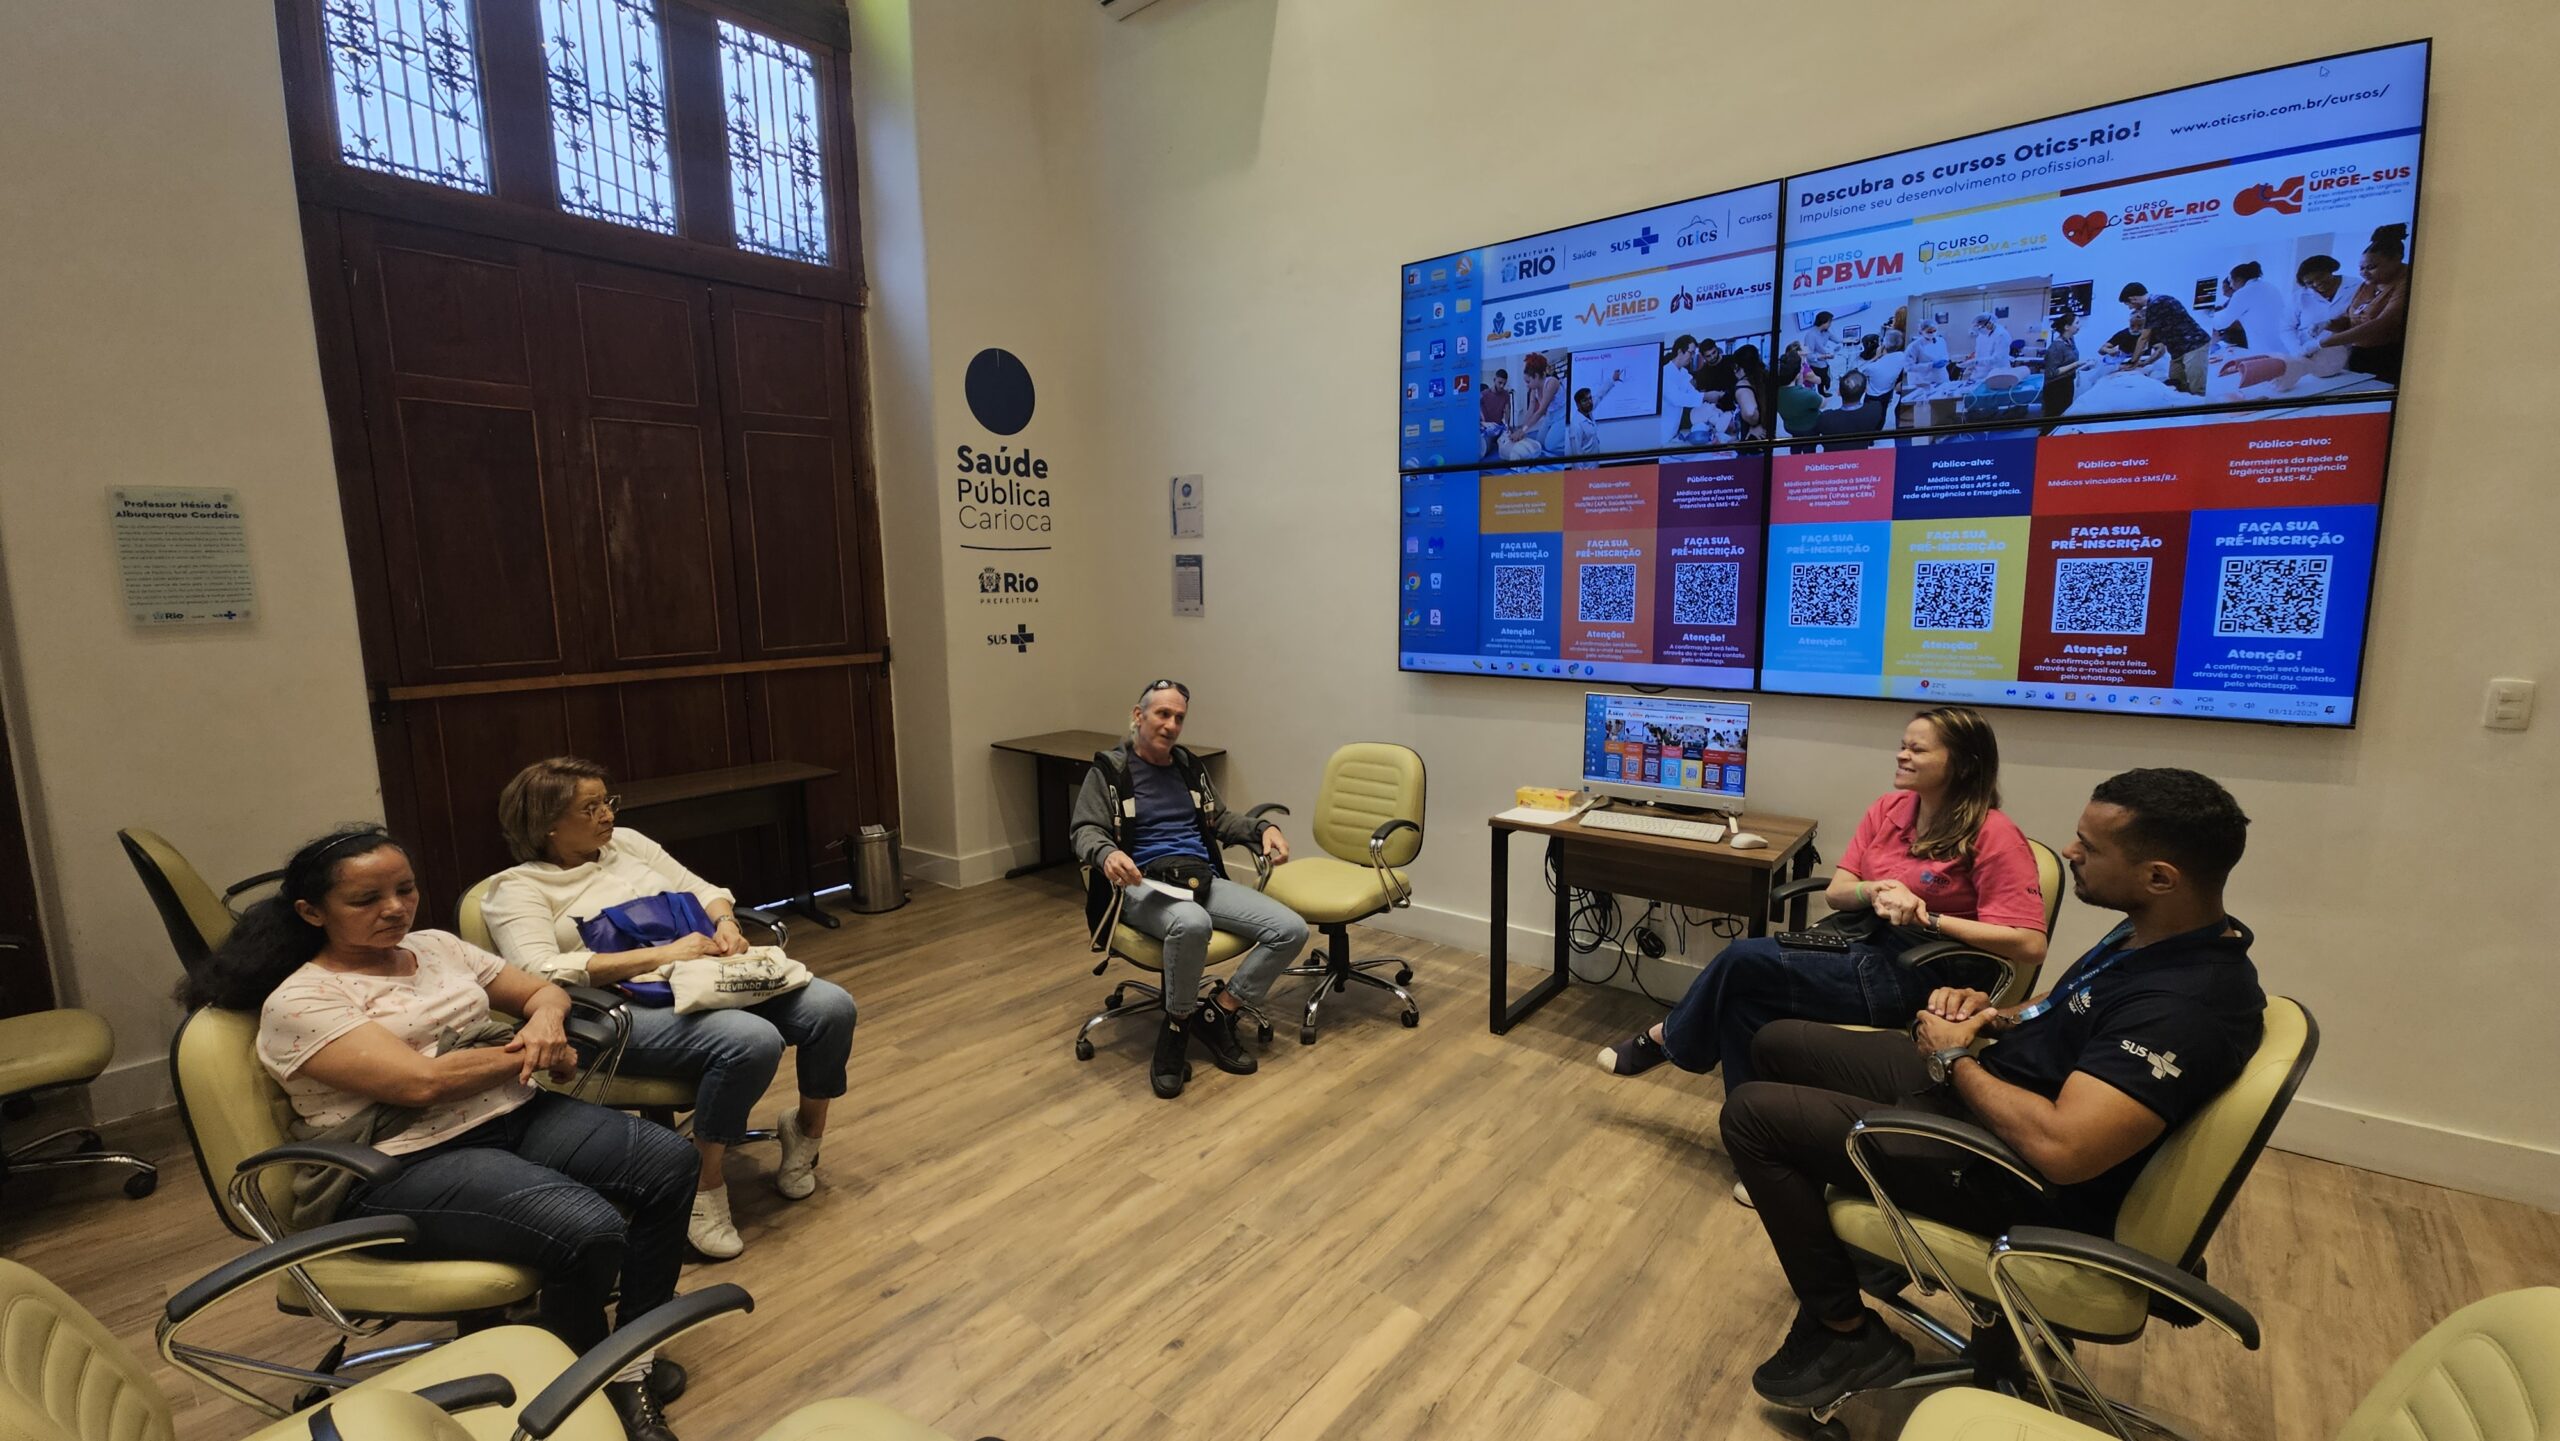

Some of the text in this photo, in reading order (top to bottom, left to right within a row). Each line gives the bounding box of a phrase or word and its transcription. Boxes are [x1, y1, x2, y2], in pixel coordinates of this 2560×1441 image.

[2170, 84, 2391, 135] www.oticsrio.com.br/cursos/
[1801, 120, 2141, 207] Descubra os cursos Otics-Rio!
[2310, 165, 2357, 179] CURSO
[2309, 166, 2411, 192] URGE-SUS
[1800, 150, 2115, 224] Impulsione seu desenvolvimento profissional.
[2123, 199, 2220, 225] SAVE-RIO
[2125, 199, 2168, 213] CURSO
[1738, 212, 1773, 225] Cursos
[1611, 239, 1631, 253] SUS
[1938, 234, 1989, 251] CURSO
[1572, 250, 1597, 261] Saúde
[1819, 250, 1863, 265] CURSO
[1519, 255, 1556, 280] RIO
[1816, 252, 1904, 287] PBVM
[1696, 282, 1772, 303] MANEVA-SUS
[1697, 282, 1727, 294] CURSO
[1606, 290, 1642, 303] CURSO
[1514, 308, 1546, 320] CURSO
[1606, 297, 1660, 318] IEMED
[1513, 315, 1563, 338] SBVE
[2249, 437, 2331, 449] Público-alvo:
[957, 445, 1048, 479] Saúde
[1805, 463, 1860, 471] Público-alvo:
[1932, 459, 1995, 469] Público-alvo:
[2077, 459, 2149, 469] Público-alvo:
[2230, 458, 2289, 467] Enfermeiros
[2306, 455, 2333, 463] Rede
[2335, 454, 2349, 462] de
[2229, 468, 2274, 477] Urgência
[2285, 464, 2347, 474] Emergência
[1687, 475, 1734, 483] Público-alvo:
[1927, 475, 1959, 483] Médicos
[2085, 477, 2132, 485] vinculados
[2257, 475, 2271, 483] da
[957, 478, 1050, 507] Pública
[1915, 483, 1959, 491] Enfermeiros
[1932, 490, 1966, 499] Urgência
[123, 500, 177, 508] Professor
[214, 501, 228, 509] de
[116, 510, 239, 519] Albuquerque Cordeiro
[959, 505, 1051, 531] Carioca
[2071, 526, 2141, 539] FAÇA SUA
[2239, 521, 2319, 535] FAÇA SUA
[1684, 537, 1730, 547] FAÇA SUA
[2051, 536, 2162, 551] PRÉ-INSCRIÇÃO
[2215, 532, 2345, 548] PRÉ-INSCRIÇÃO
[1671, 546, 1745, 557] PRÉ-INSCRIÇÃO
[1004, 572, 1039, 593] Rio
[1501, 627, 1535, 637] Atenção!
[1586, 631, 1625, 640] Atenção!
[1683, 633, 1726, 643] Atenção!
[987, 633, 1007, 645] SUS
[2063, 644, 2128, 657] Atenção!
[2227, 649, 2302, 662] Atenção!
[2051, 658, 2105, 666] confirmação
[2126, 659, 2147, 667] feita
[2212, 664, 2275, 672] confirmação
[2080, 674, 2125, 682] whatsapp.
[2120, 1039, 2149, 1058] SUS
